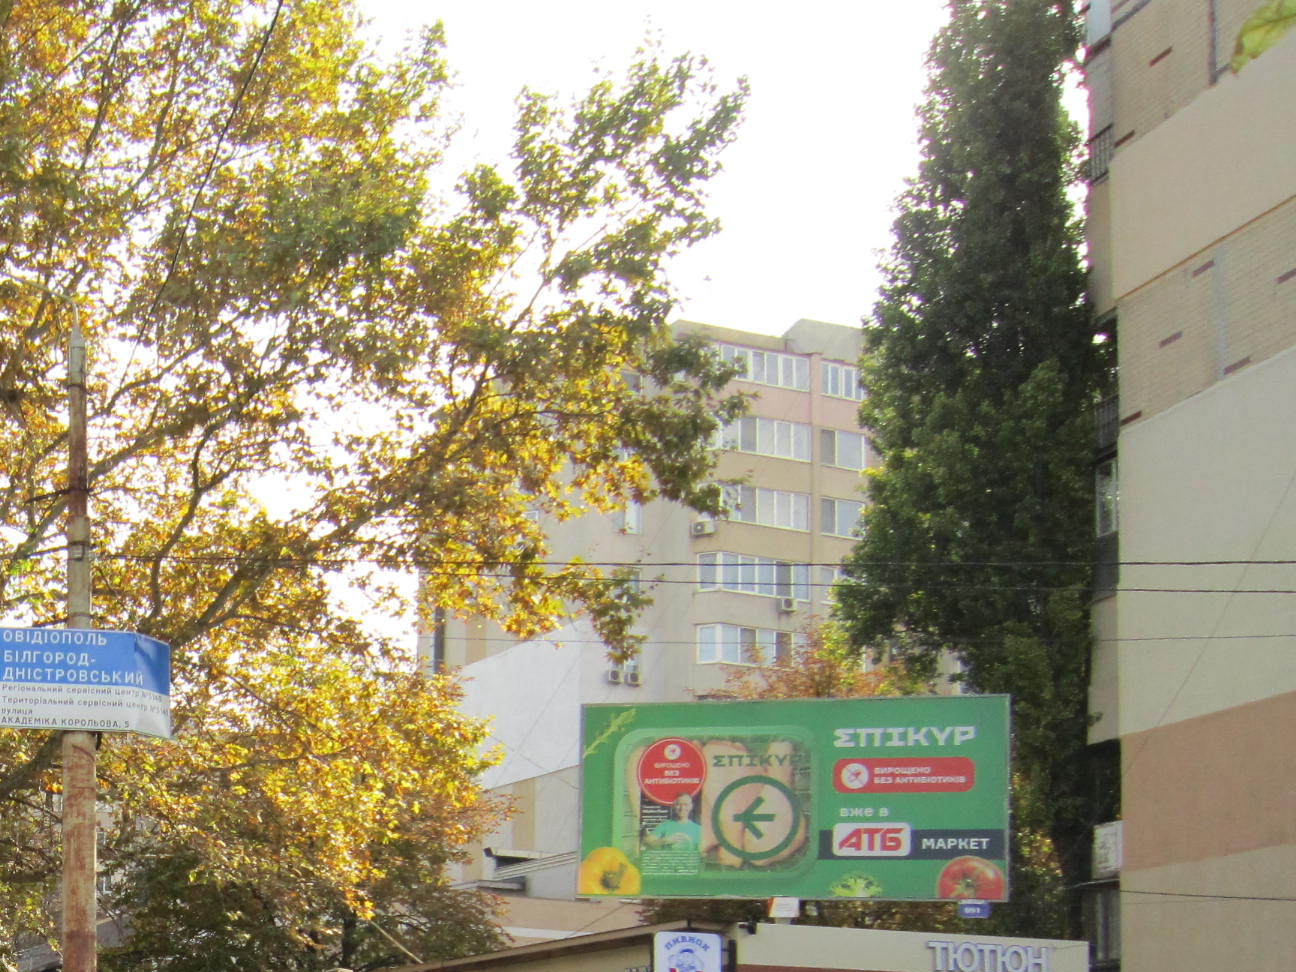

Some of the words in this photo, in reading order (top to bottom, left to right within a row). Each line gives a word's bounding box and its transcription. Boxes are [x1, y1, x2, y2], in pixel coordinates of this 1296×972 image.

[3, 630, 108, 646] ОВІДІОПОЛЬ
[4, 650, 97, 668] БІЛГОРОД-
[2, 667, 144, 686] ДНІСТРОВСЬКИЙ
[2, 684, 63, 694] Регіональний
[66, 687, 112, 696] сервісний
[2, 696, 75, 706] Територіальний
[78, 699, 123, 708] сервісний
[1, 716, 58, 726] АКАДЕМІКА
[874, 766, 932, 775] ВИРОЩЕНО
[874, 776, 893, 784] БЕЗ
[839, 807, 874, 818] вже
[879, 807, 889, 817] в
[837, 827, 904, 852] АТБ
[922, 837, 991, 850] МАРКЕТ
